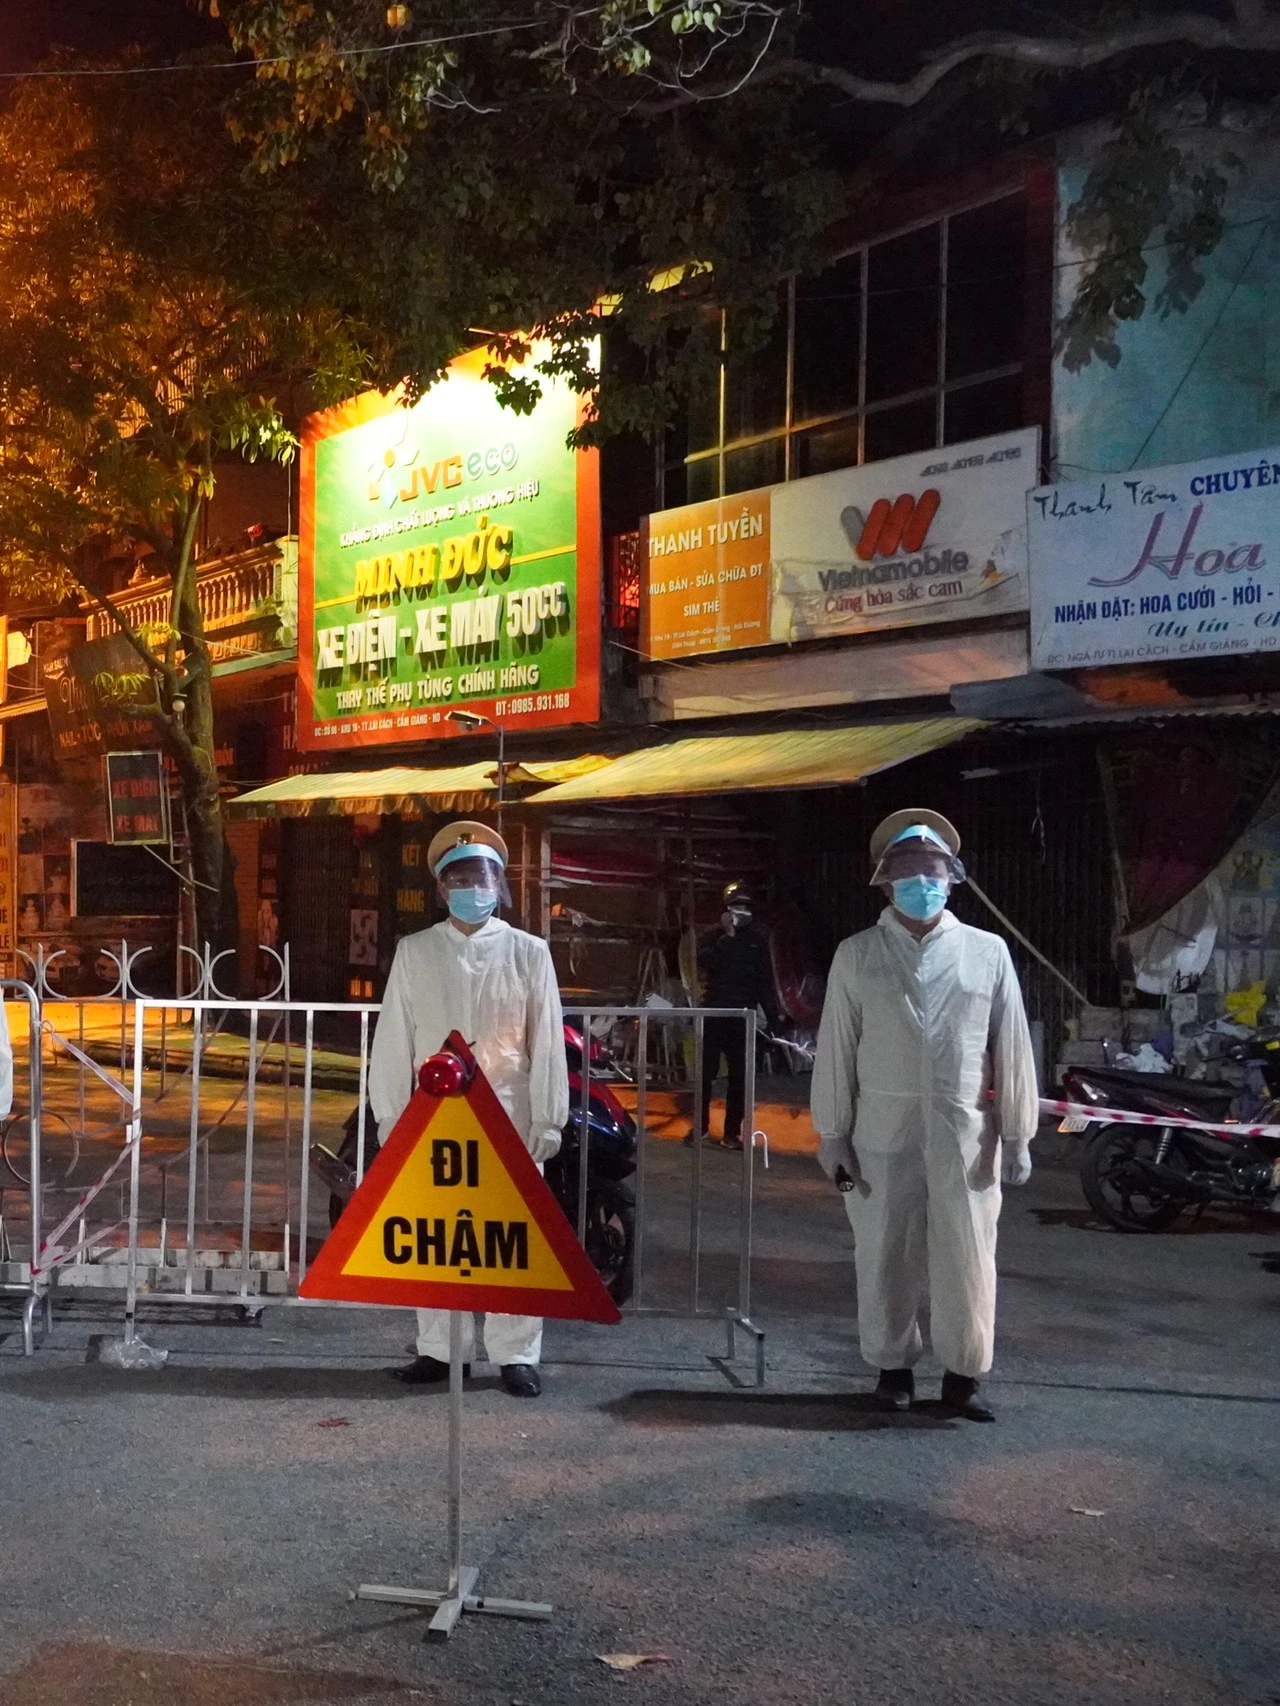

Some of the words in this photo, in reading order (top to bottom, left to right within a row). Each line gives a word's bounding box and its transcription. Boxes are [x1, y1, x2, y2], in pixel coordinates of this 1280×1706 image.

[399, 455, 463, 501] JVC
[467, 442, 518, 480] eco
[354, 543, 439, 598] MINH
[439, 513, 513, 580] ĐỨC
[648, 526, 703, 558] THANH
[1088, 499, 1268, 587] Hoa
[648, 583, 667, 596] MUA
[669, 576, 688, 592] BÁN
[696, 570, 715, 588] SỬA
[749, 563, 763, 577] ĐT
[818, 549, 969, 592] Vietnamobile
[928, 580, 963, 598] cam
[683, 604, 700, 618] SIM
[1055, 600, 1097, 625] NHẬN
[1101, 595, 1135, 622] ĐẶT:
[1140, 594, 1173, 615] HOA
[1177, 585, 1216, 611] CƯỚI
[1233, 577, 1262, 605] HỎI
[316, 627, 345, 670] XE
[347, 609, 397, 672] ĐIỆN
[415, 606, 448, 654] XE
[451, 585, 502, 649] MÁY
[336, 688, 364, 710] THAY
[366, 678, 389, 706] THẾ
[390, 681, 412, 708] PHỤ
[417, 676, 453, 700] TÙNG
[458, 667, 495, 694] CHÍNH
[500, 662, 539, 688] HÃNG
[430, 1138, 479, 1188] ĐI
[382, 1208, 529, 1277] CHẬM
